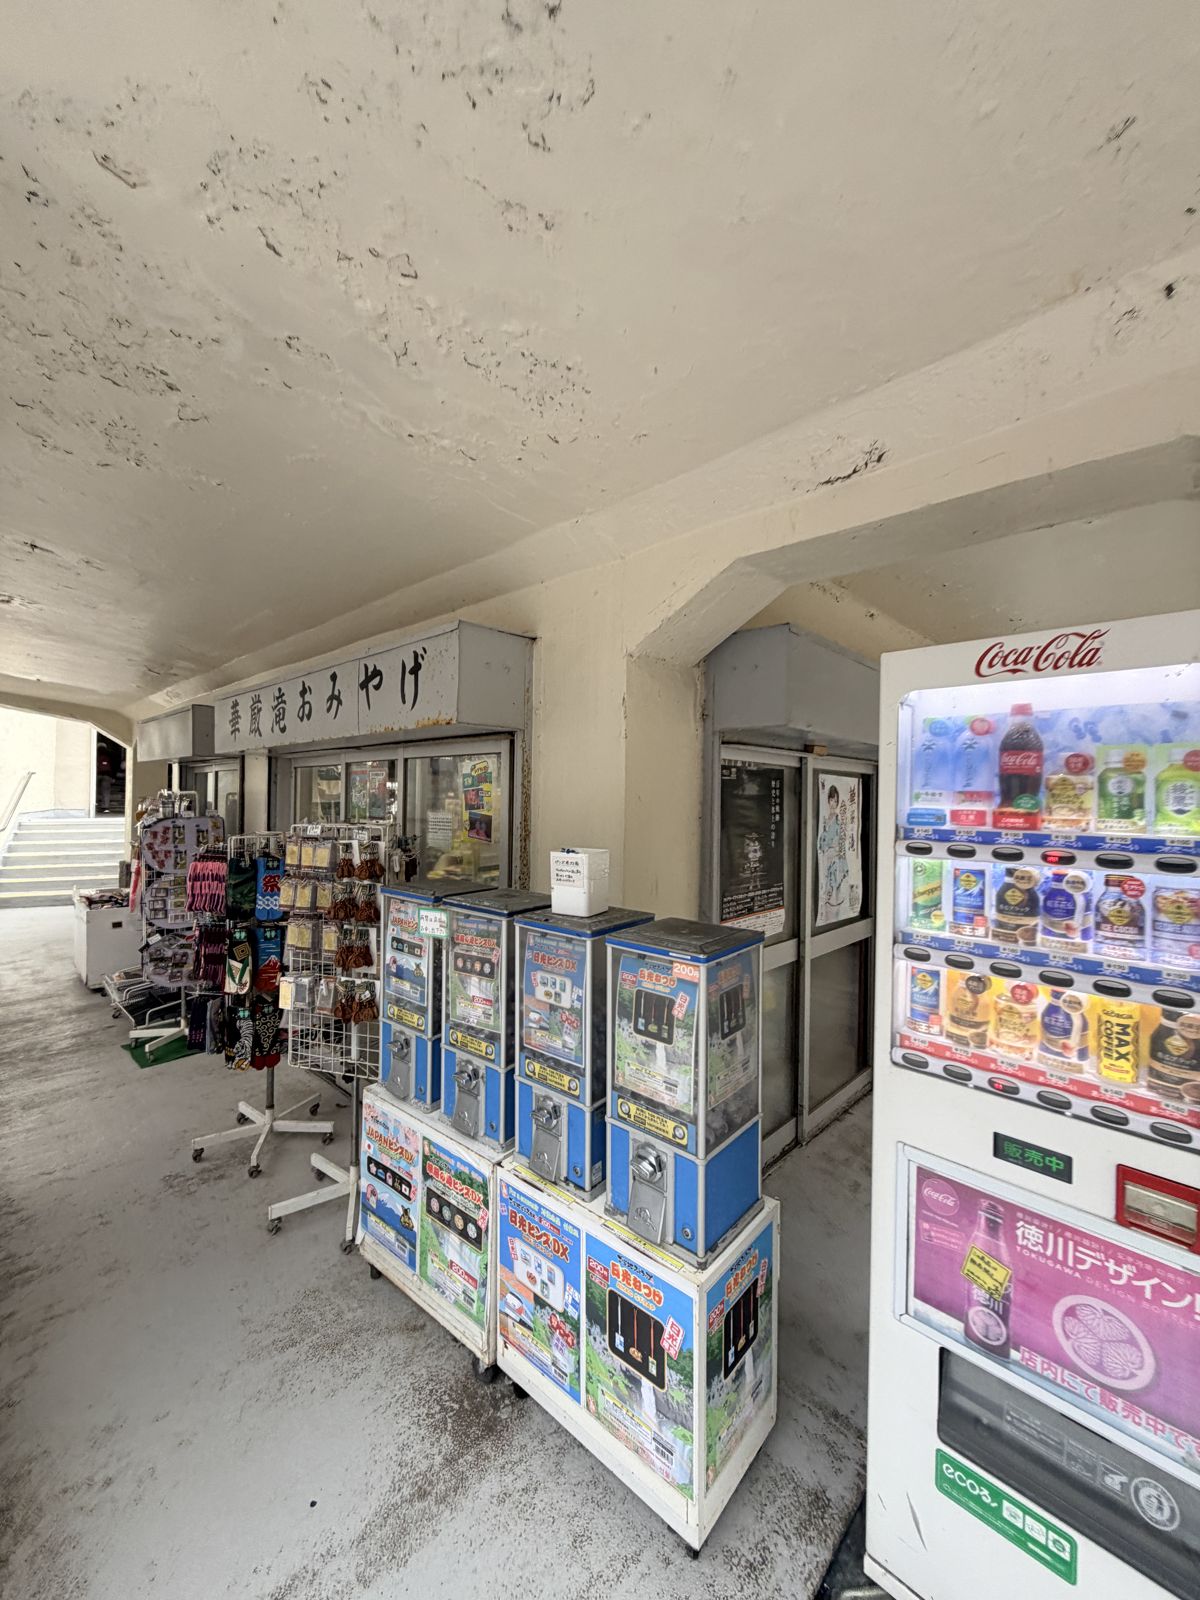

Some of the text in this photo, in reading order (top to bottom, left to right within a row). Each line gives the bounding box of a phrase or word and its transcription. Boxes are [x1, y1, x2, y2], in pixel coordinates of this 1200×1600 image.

[974, 628, 1111, 678] Coca-Cola
[228, 646, 428, 742] 華厳滝おみやげ
[1103, 1019, 1116, 1061] COFFEE
[1114, 1022, 1132, 1062] MAX
[1003, 1141, 1066, 1173] 販売中
[923, 1187, 958, 1207] Coca-Cola
[508, 1208, 570, 1264] 日光ピンズDX
[1015, 1245, 1082, 1280] TOKUGAWA
